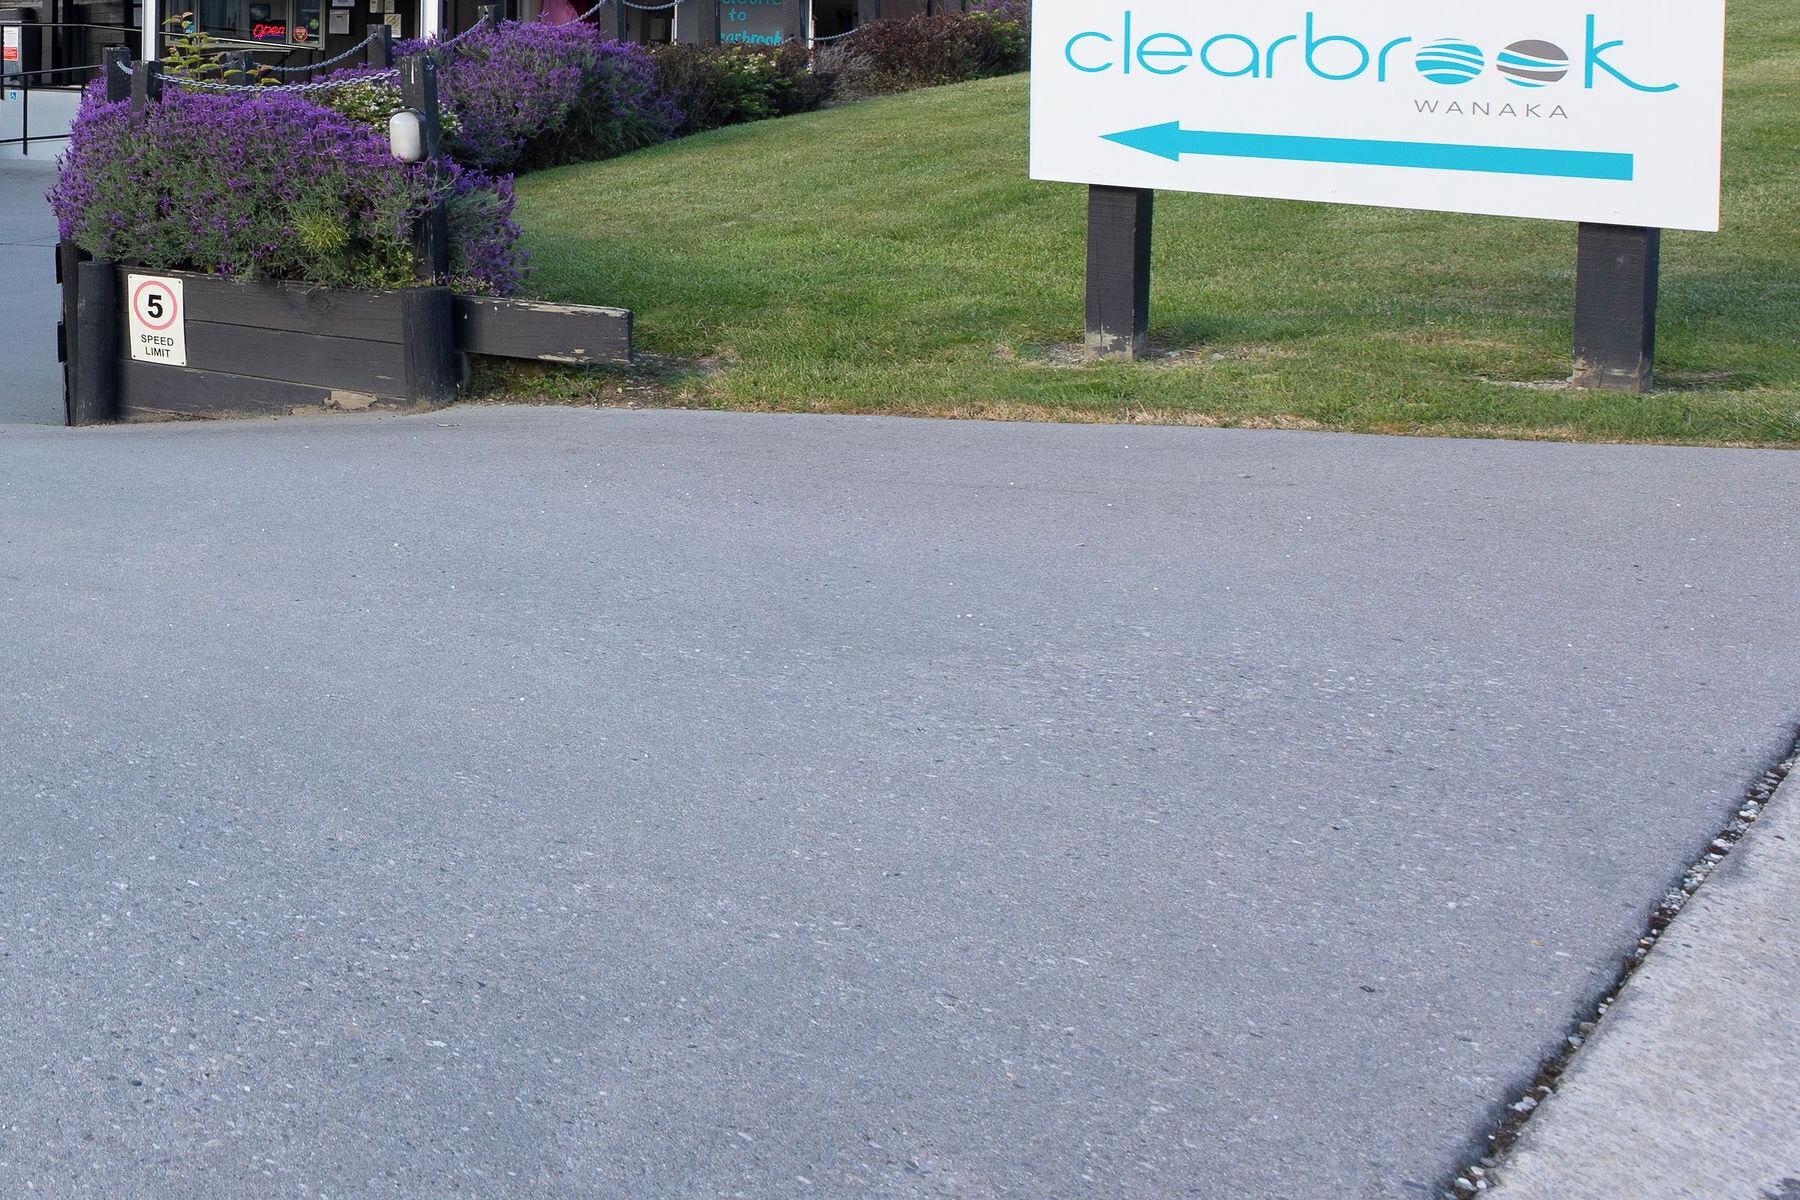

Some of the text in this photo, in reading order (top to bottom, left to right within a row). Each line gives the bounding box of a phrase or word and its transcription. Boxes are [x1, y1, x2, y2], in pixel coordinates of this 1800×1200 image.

[728, 7, 747, 22] to
[252, 23, 286, 40] Open
[1065, 10, 1681, 94] clearbrook
[1413, 99, 1569, 120] WANAKA
[147, 293, 164, 319] 5
[141, 334, 174, 346] SPEED
[145, 347, 170, 357] LIMIT
